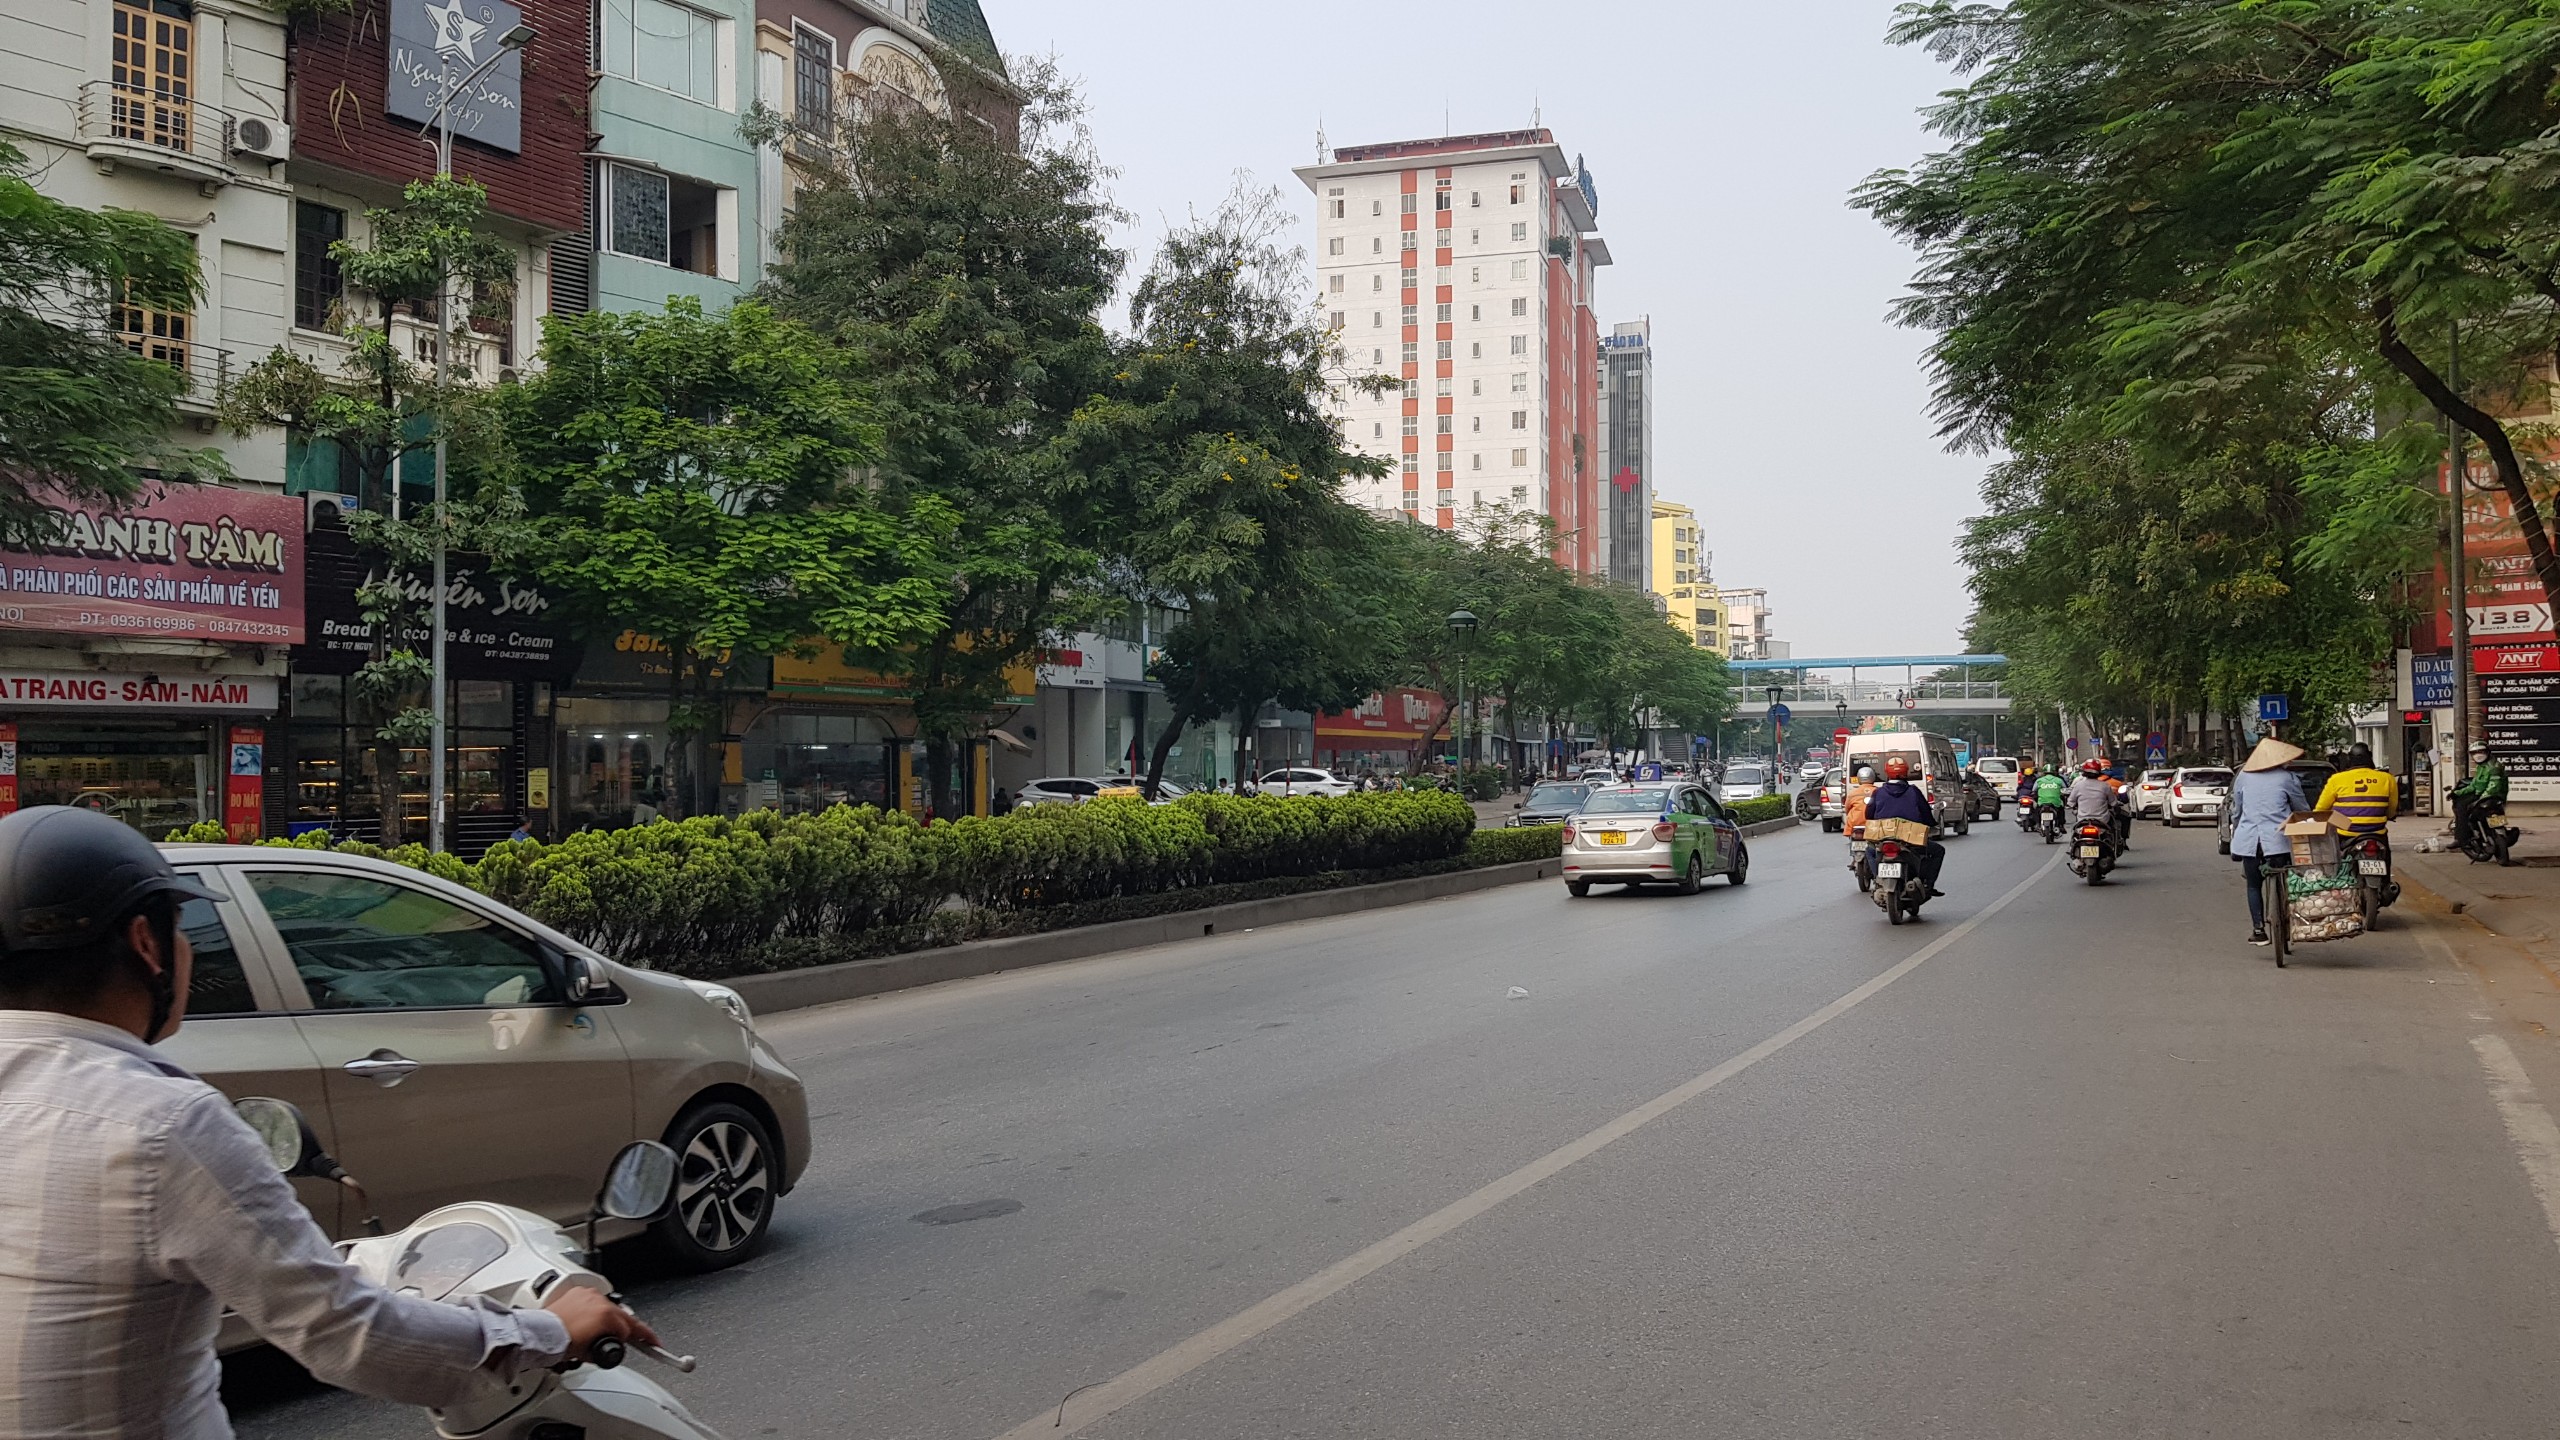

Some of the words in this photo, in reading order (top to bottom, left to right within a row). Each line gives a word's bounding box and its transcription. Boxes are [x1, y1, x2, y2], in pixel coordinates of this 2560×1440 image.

[446, 11, 463, 41] S
[5, 510, 177, 562] ANH
[182, 515, 282, 570] TÂM
[12, 565, 59, 594] PHÂN
[64, 566, 102, 597] PHỐI
[107, 570, 139, 599] CÁC
[143, 572, 176, 602] SẢN
[180, 574, 225, 605] PHẨM
[229, 578, 248, 607] VỀ
[251, 580, 280, 609] YẾN
[110, 614, 196, 631] 0936169986
[209, 620, 290, 636] 0847432345
[2479, 611, 2530, 626] 138
[322, 619, 371, 638] Bread
[508, 631, 554, 649] Cream
[2414, 661, 2431, 673] HD
[2433, 660, 2454, 672] AUT
[2501, 653, 2538, 665] ANT
[2416, 675, 2439, 686] MUA
[2441, 671, 2454, 684] BÁ
[11, 678, 107, 701] TRANG
[192, 676, 248, 704] NẤM
[2427, 686, 2435, 699] Ô
[2436, 686, 2452, 698] TÔ
